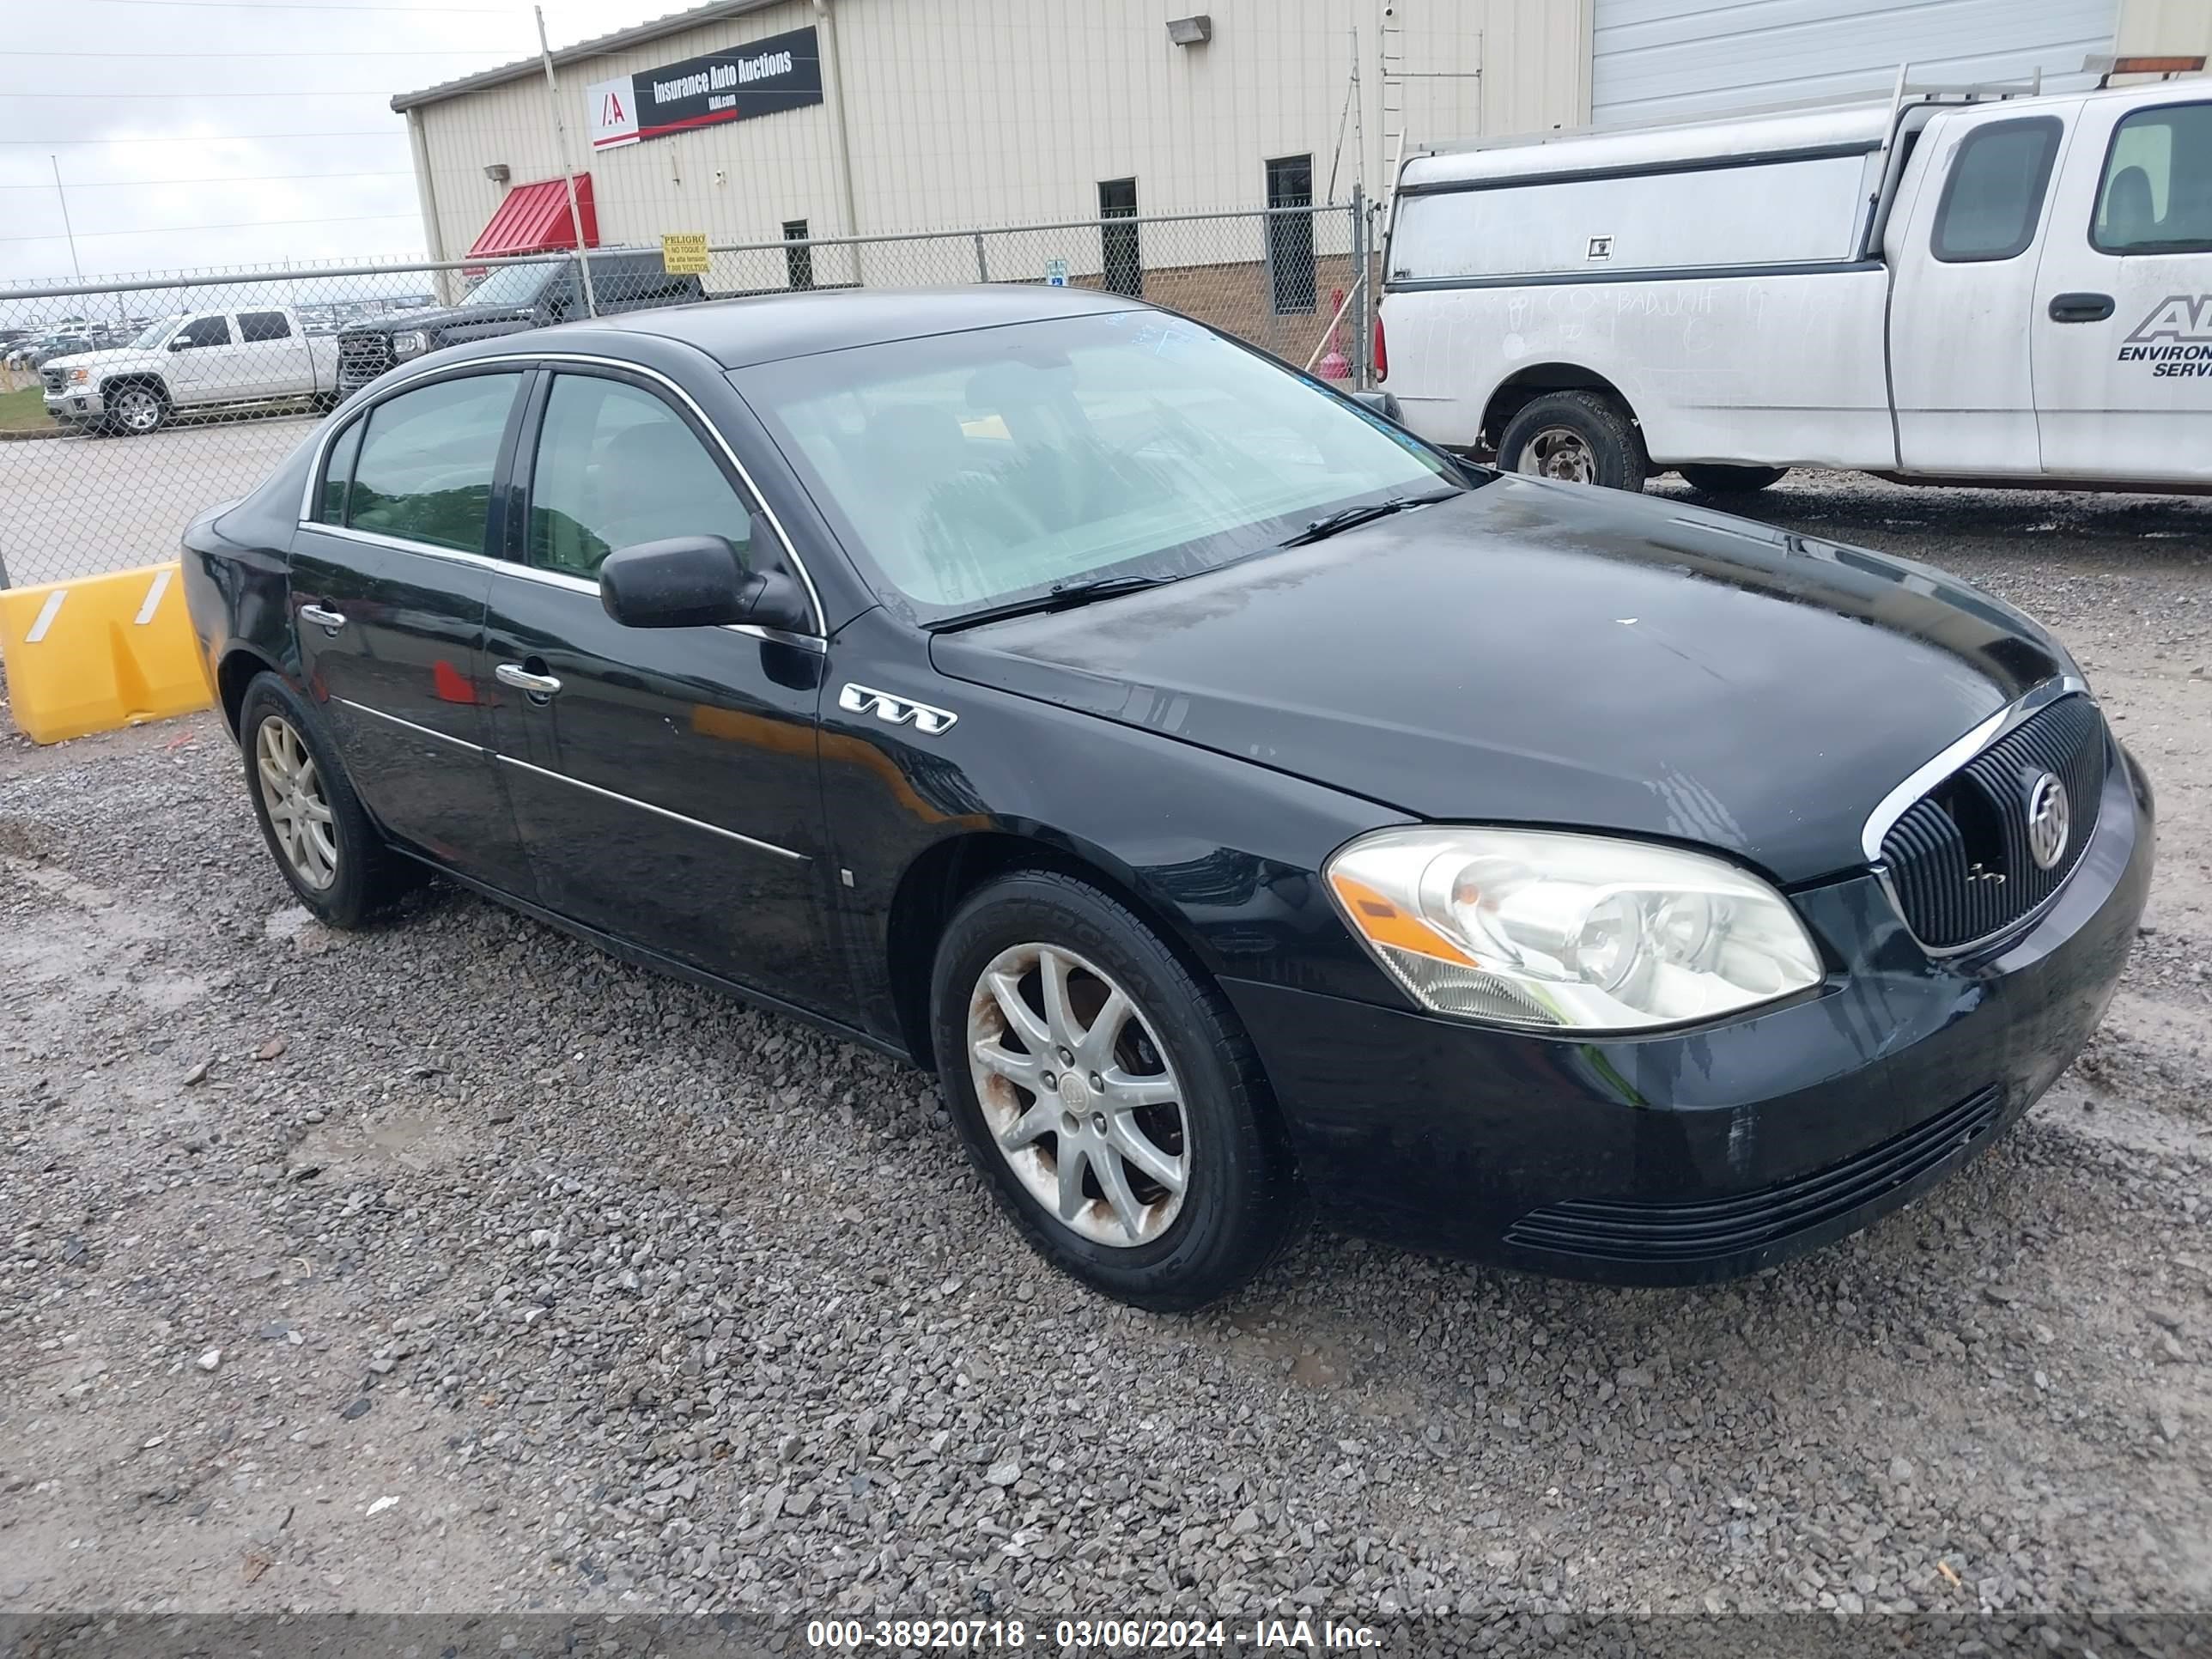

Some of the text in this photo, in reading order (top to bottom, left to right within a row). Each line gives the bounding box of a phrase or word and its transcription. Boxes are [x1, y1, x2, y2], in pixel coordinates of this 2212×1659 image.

[653, 50, 793, 104] Insurance Auto Auctions
[665, 235, 706, 244] PELIGRO
